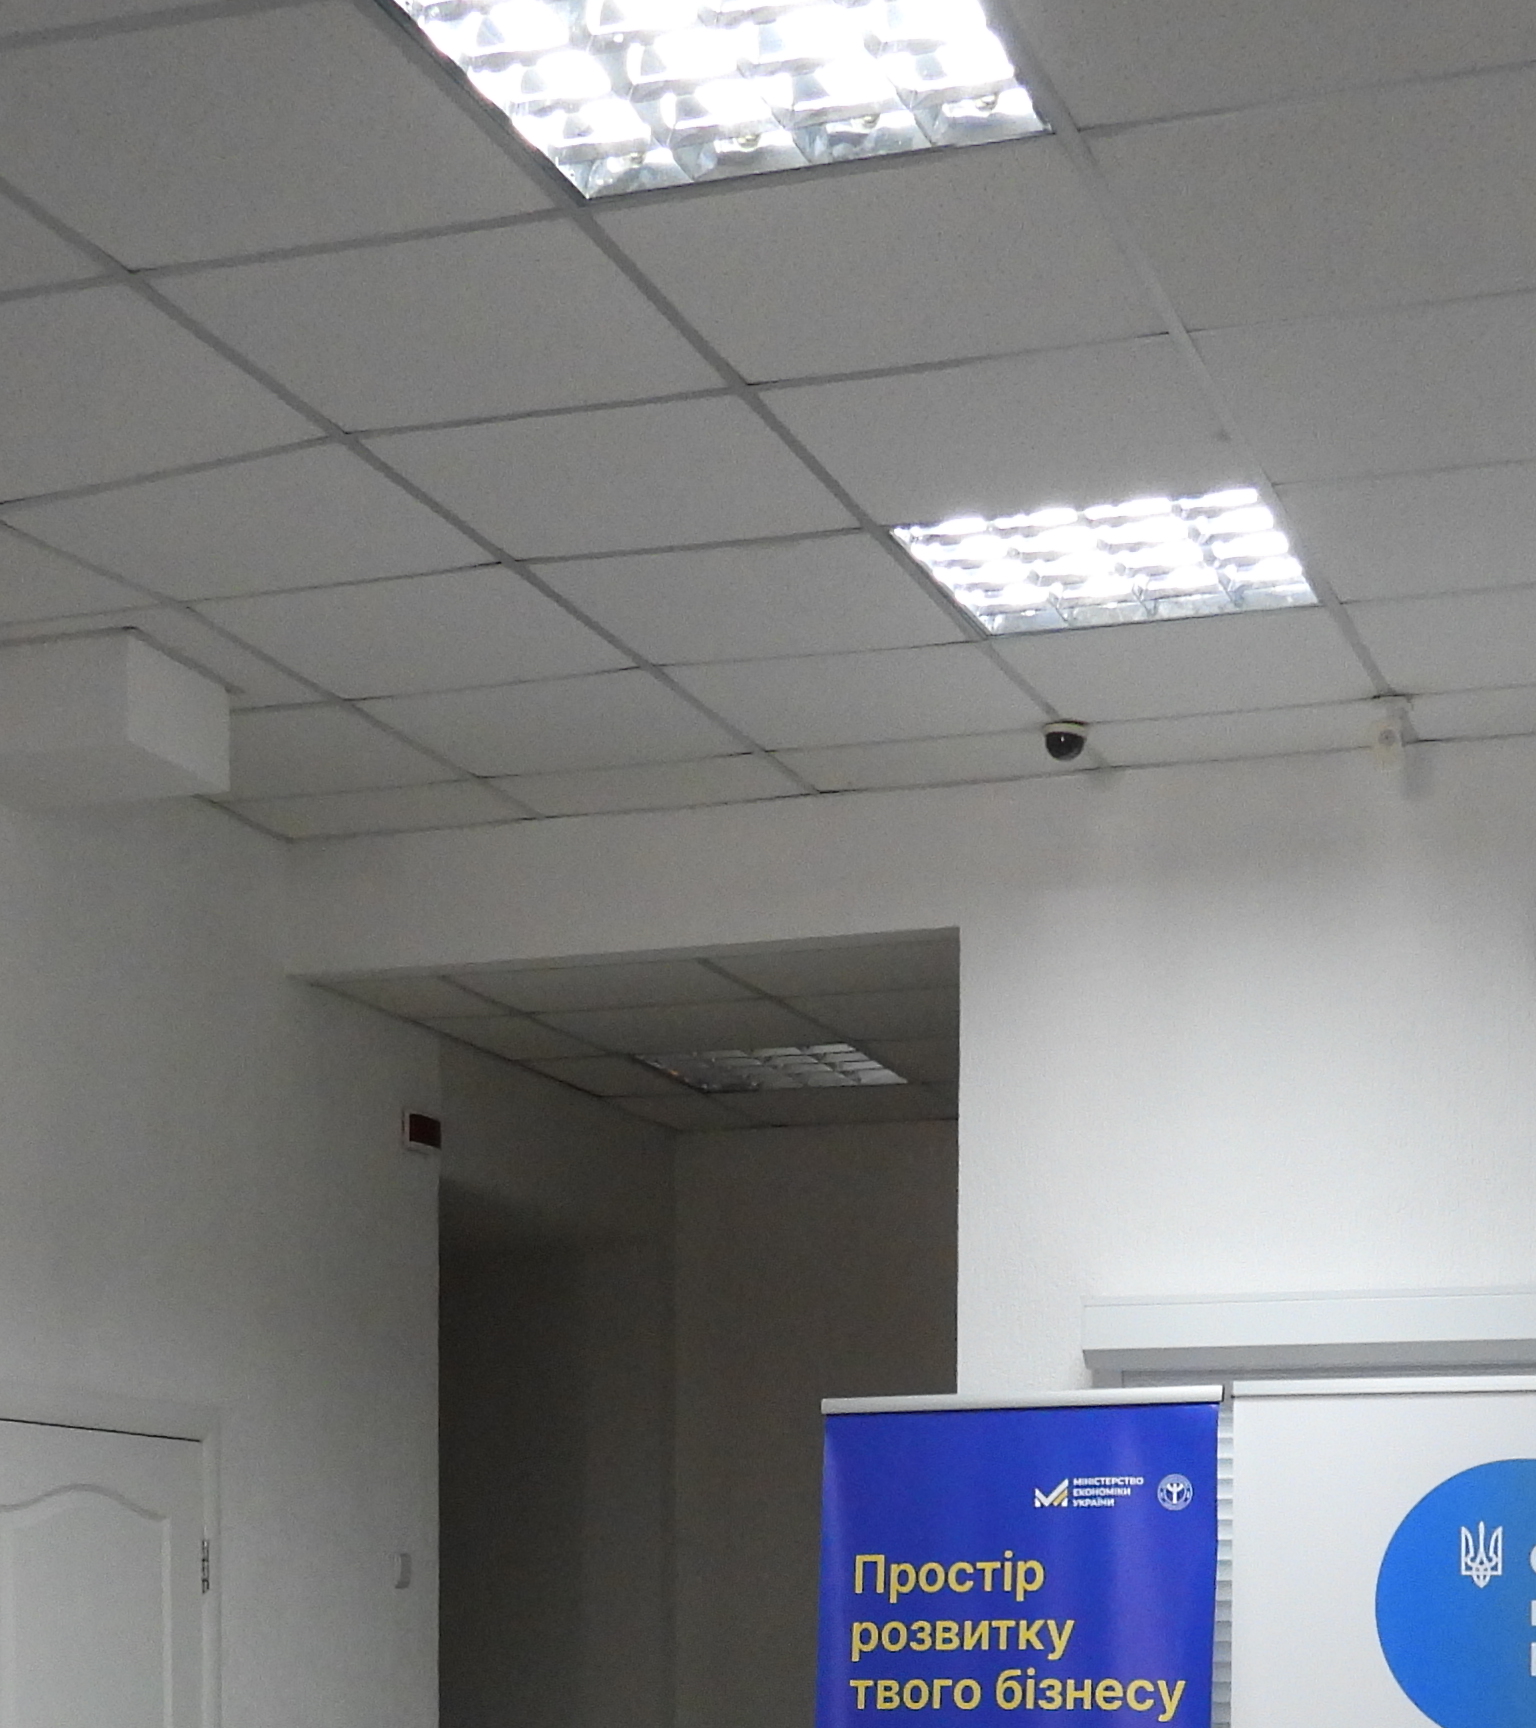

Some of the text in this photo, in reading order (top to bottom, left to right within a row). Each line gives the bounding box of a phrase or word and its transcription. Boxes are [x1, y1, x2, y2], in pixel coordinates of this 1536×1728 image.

[1072, 1487, 1132, 1497] ЕКОНОМІКИ
[1073, 1476, 1144, 1486] МІНІСТЕРСТВО
[1072, 1497, 1115, 1508] УКРАЇНИ
[854, 1550, 1045, 1604] Простір
[851, 1617, 1075, 1662] розвитку
[850, 1667, 1187, 1723] твого бізнесу
